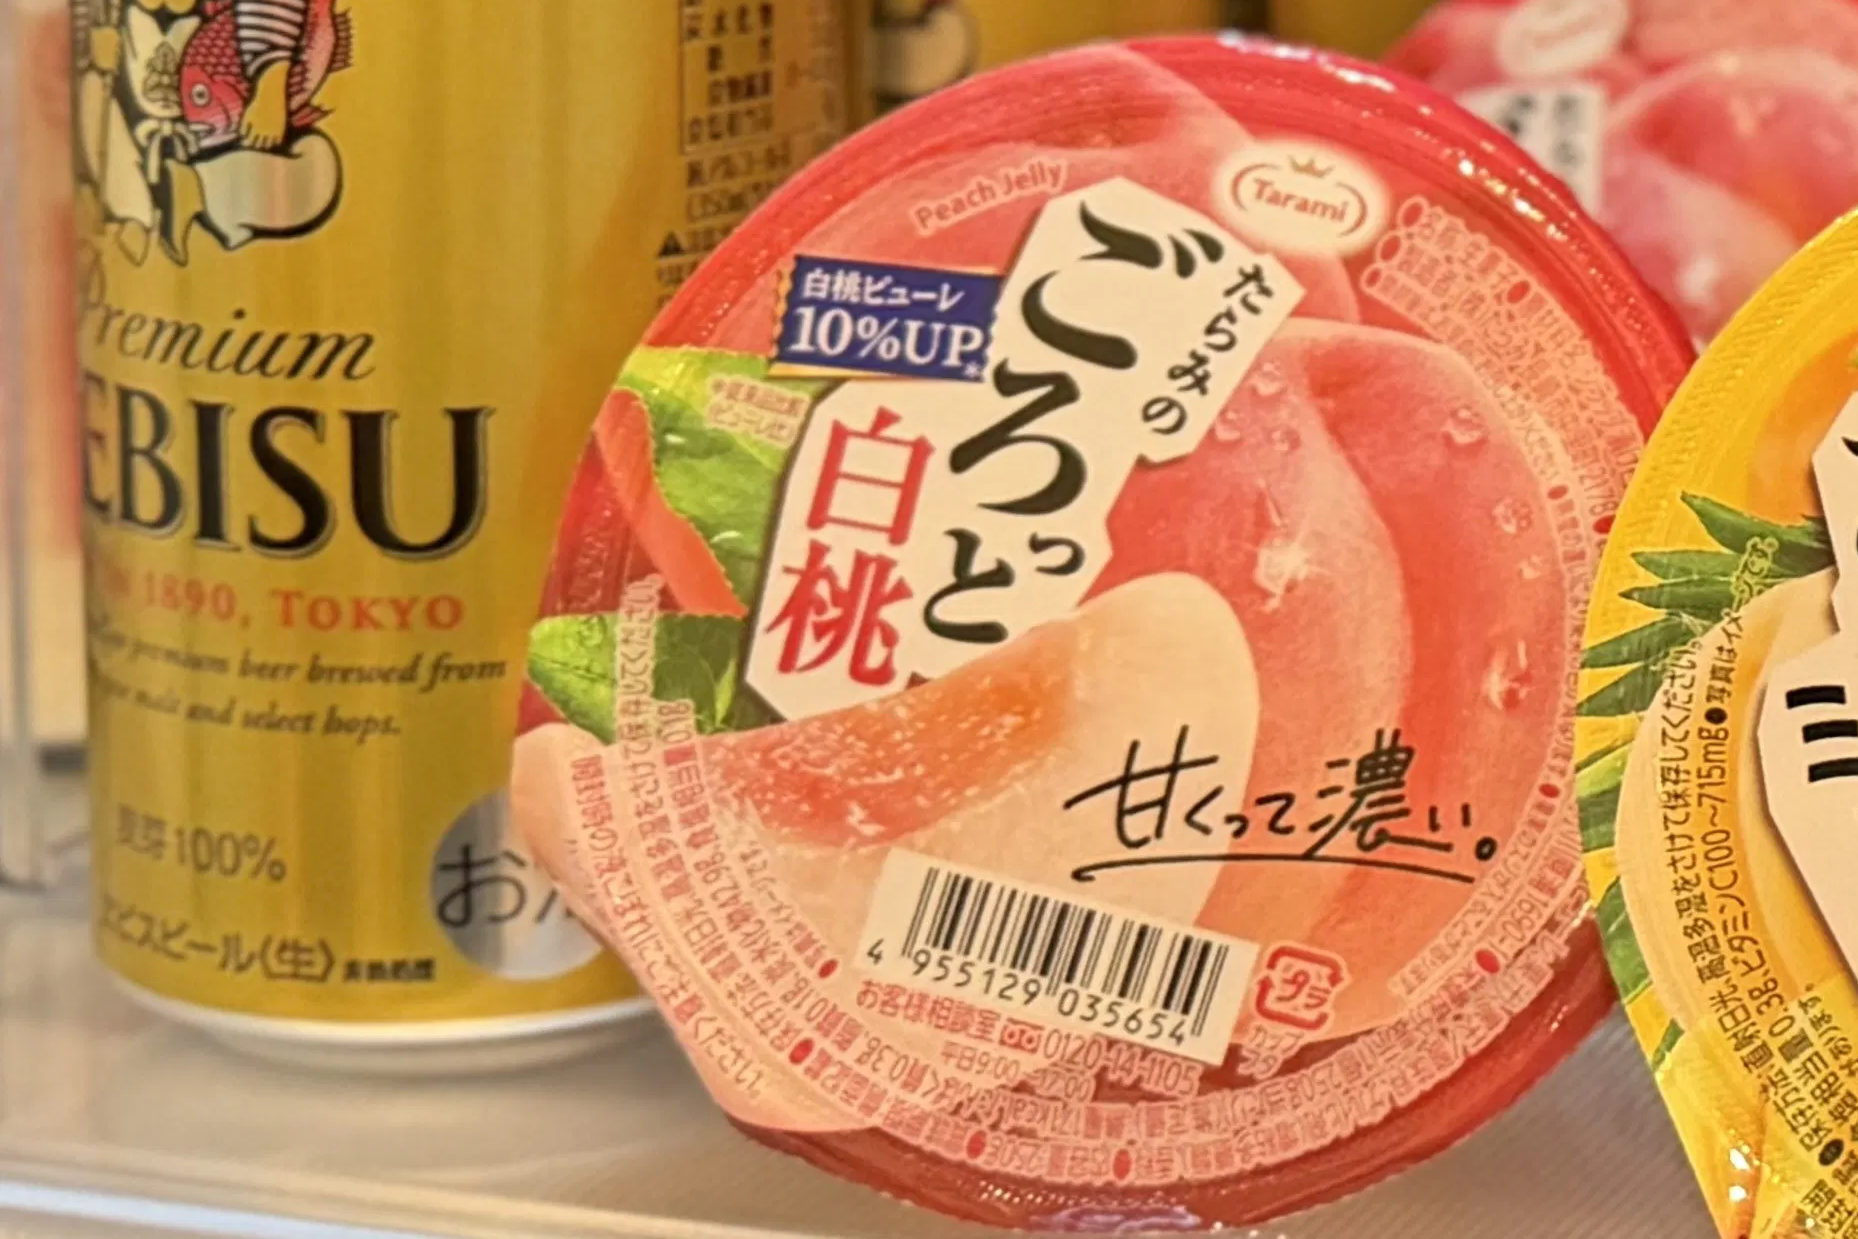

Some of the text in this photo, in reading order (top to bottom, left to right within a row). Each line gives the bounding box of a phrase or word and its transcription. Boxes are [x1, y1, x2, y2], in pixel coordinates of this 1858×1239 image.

[913, 159, 1067, 235] Peach Jelly
[1251, 177, 1351, 225] Tarami
[78, 250, 378, 382] Premium
[803, 265, 966, 313] 白桃ピューレ
[1141, 261, 1275, 437] たらみの
[922, 200, 1225, 645] ごろっと
[765, 404, 936, 688] 白桃
[270, 587, 465, 632] TOKYO
[418, 651, 507, 694] from
[1063, 725, 1499, 863] 甘くって濃い。
[865, 938, 1188, 1049] 4 955129 035654
[1275, 969, 1333, 1011] プラ
[1042, 1026, 1199, 1094] 0120-14-1105
